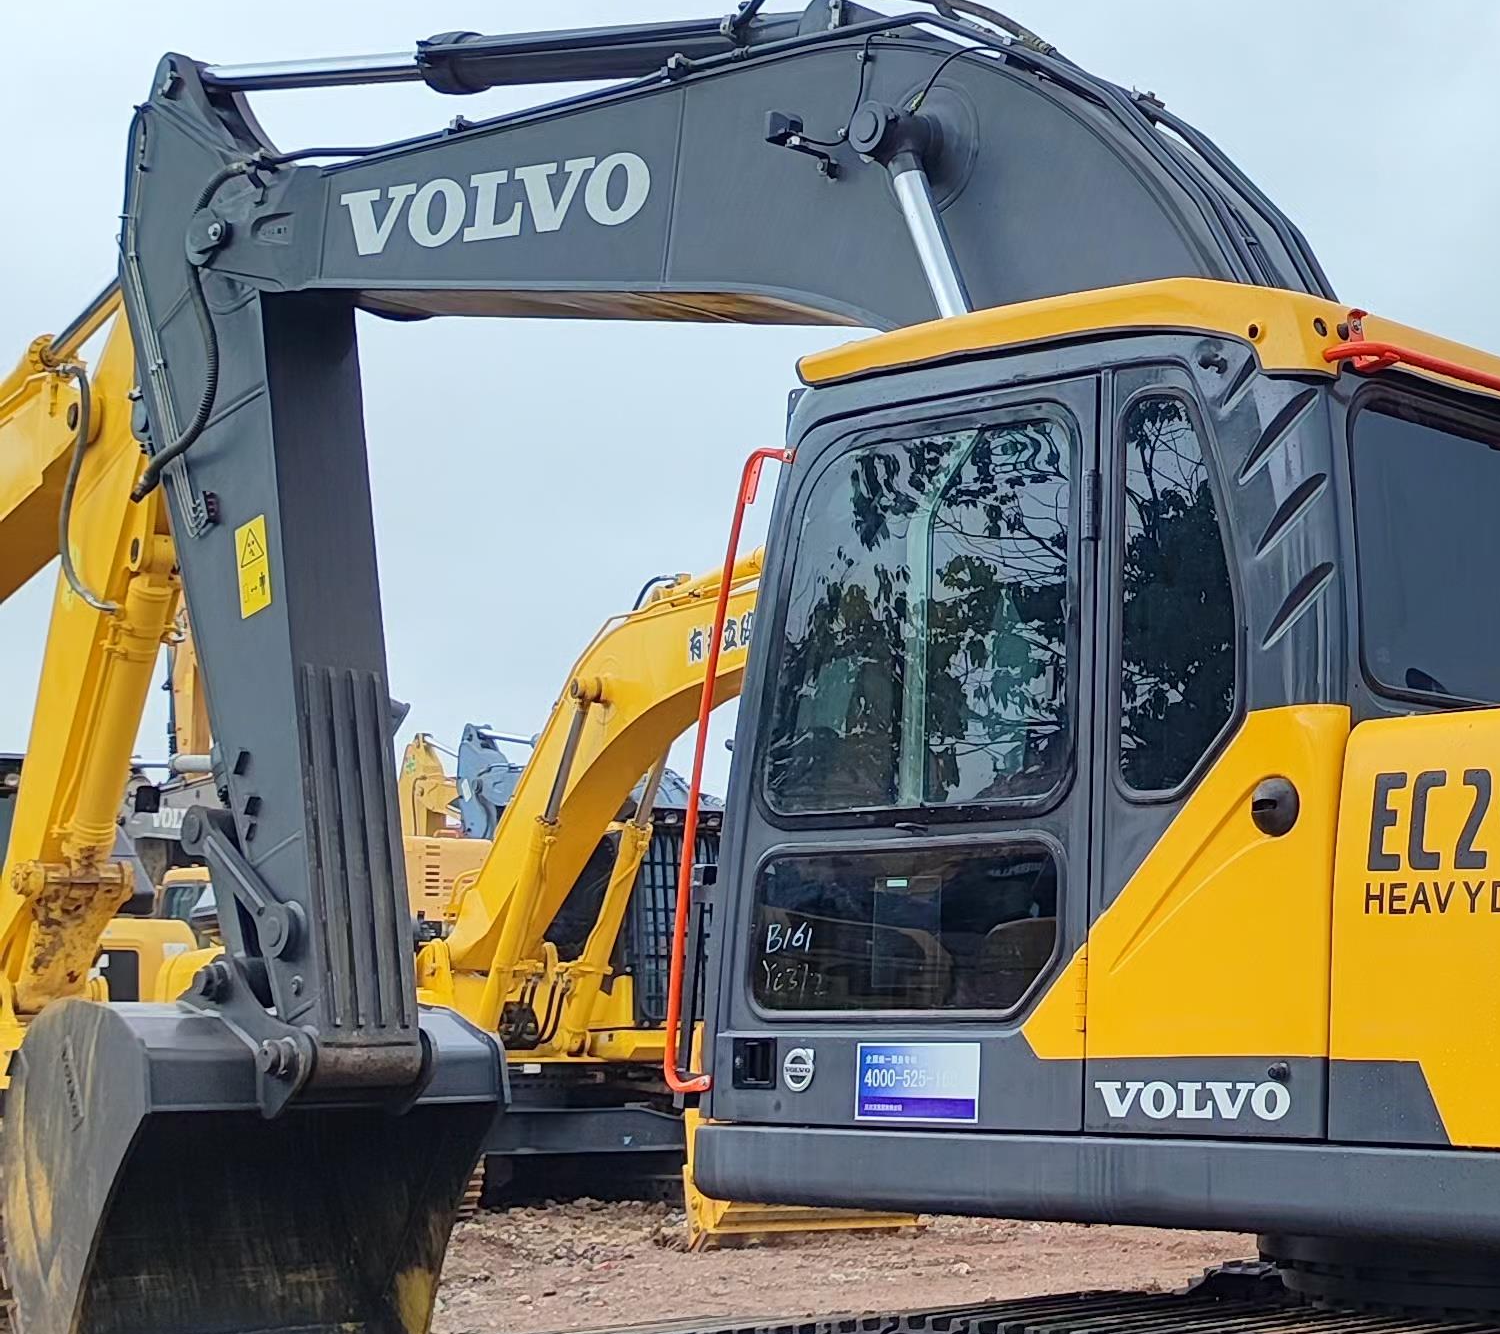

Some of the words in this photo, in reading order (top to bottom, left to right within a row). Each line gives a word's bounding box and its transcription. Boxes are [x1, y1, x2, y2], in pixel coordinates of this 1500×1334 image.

[340, 152, 651, 256] VOLVO
[152, 807, 189, 829] VOL
[766, 921, 813, 954] B161
[1094, 1081, 1291, 1121] VOLVO
